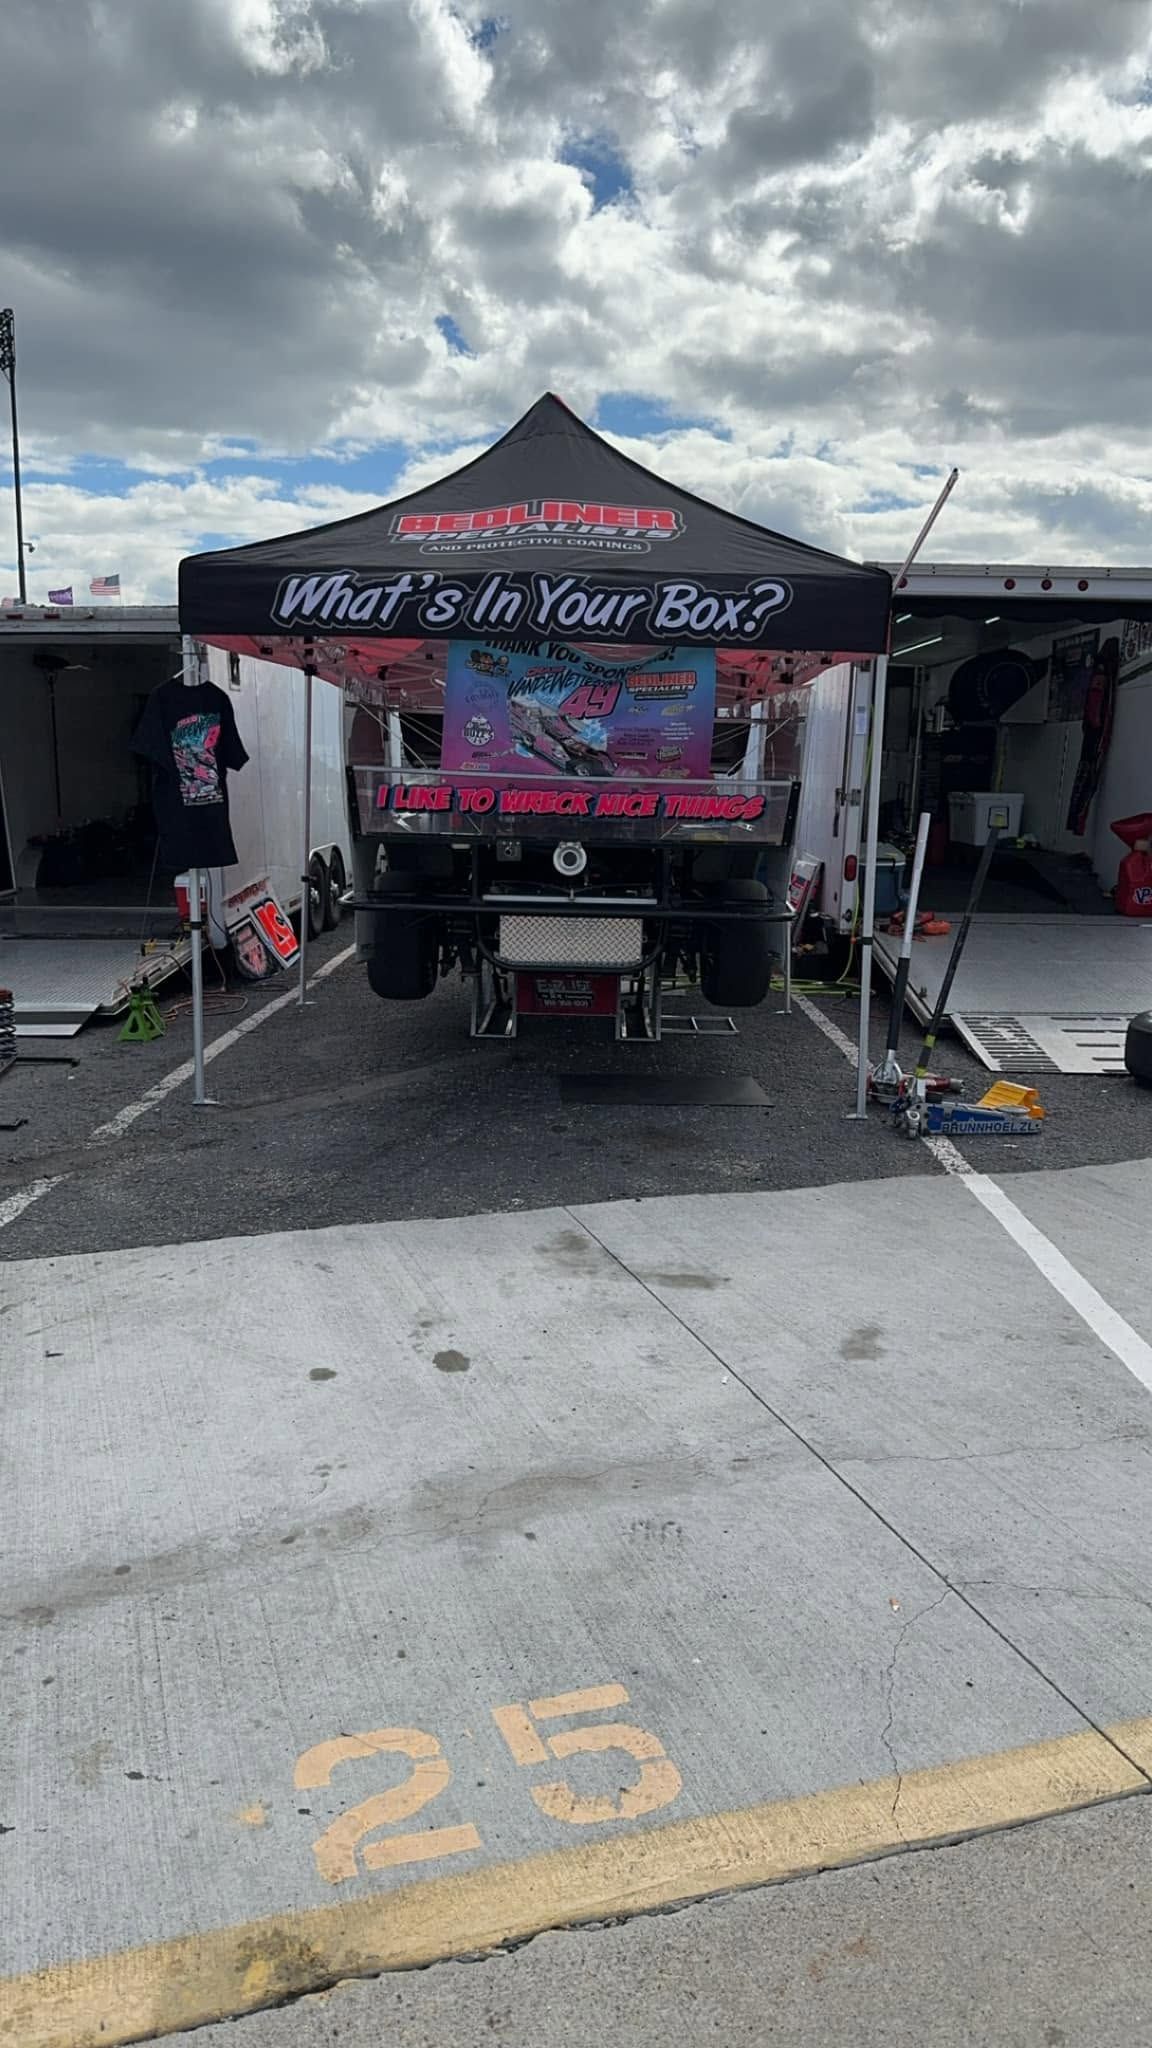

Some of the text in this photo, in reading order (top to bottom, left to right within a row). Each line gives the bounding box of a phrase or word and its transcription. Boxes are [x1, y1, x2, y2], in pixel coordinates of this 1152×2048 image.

[397, 501, 678, 533] BEDLINER
[399, 523, 673, 542] SPECIALISTS
[429, 538, 643, 553] AND PROTECTIVE COATINGS
[279, 574, 786, 633] What's In Your Box?
[558, 682, 622, 719] 49
[376, 784, 766, 820] I LIKE TO WRECK NICE THINGS
[942, 1120, 1036, 1133] BRUNNHOELZL
[293, 1683, 683, 1885] 25
